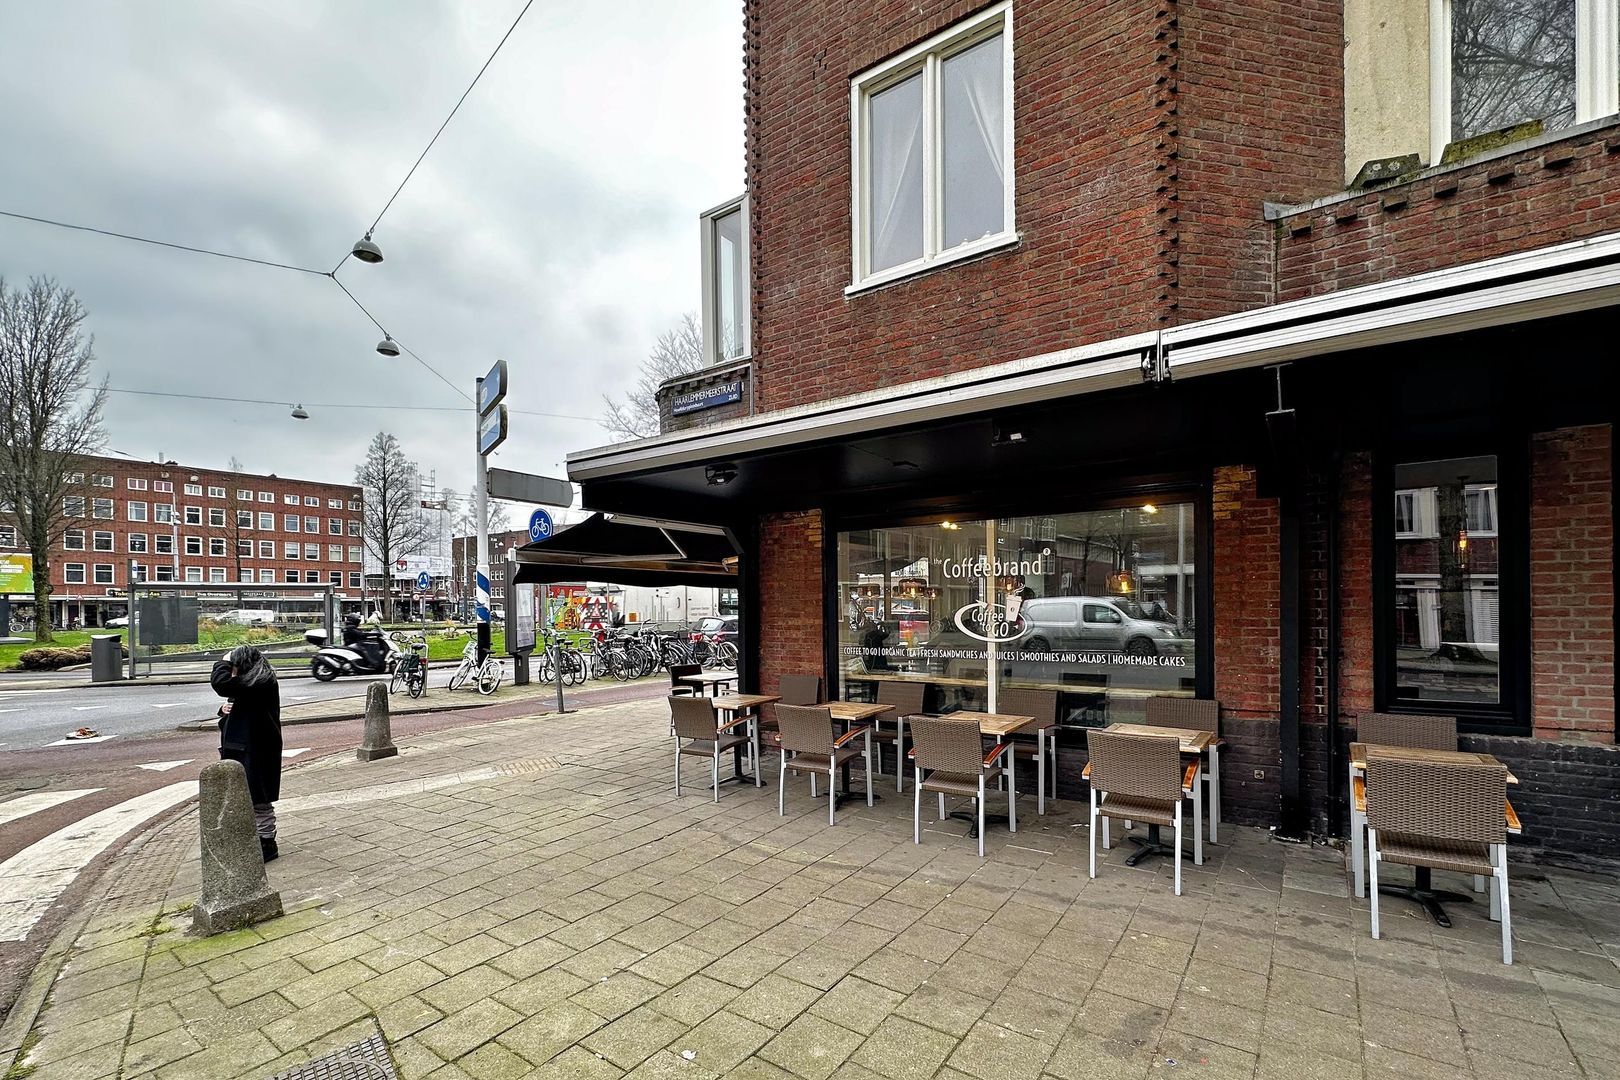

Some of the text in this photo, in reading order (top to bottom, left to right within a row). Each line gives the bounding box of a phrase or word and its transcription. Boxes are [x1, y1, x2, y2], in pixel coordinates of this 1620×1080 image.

[674, 383, 737, 406] HAARLEMMERMEERSTRAAT
[943, 554, 1042, 579] Coffeebrand
[971, 608, 1004, 622] Coffee
[991, 622, 1009, 637] GO
[843, 647, 862, 656] COFFEE
[862, 648, 870, 656] TO
[870, 648, 878, 656] GO
[881, 648, 905, 657] ORGANIC
[920, 649, 939, 658] FRESH
[939, 649, 978, 660] SANDWICHES
[995, 651, 1015, 660] UICES
[1020, 651, 1060, 662] SMOOTHIES
[1060, 652, 1077, 663] AND
[1077, 653, 1106, 664] SALADS
[1112, 655, 1158, 666] HOMEMADE
[1158, 656, 1186, 667] CAKES
